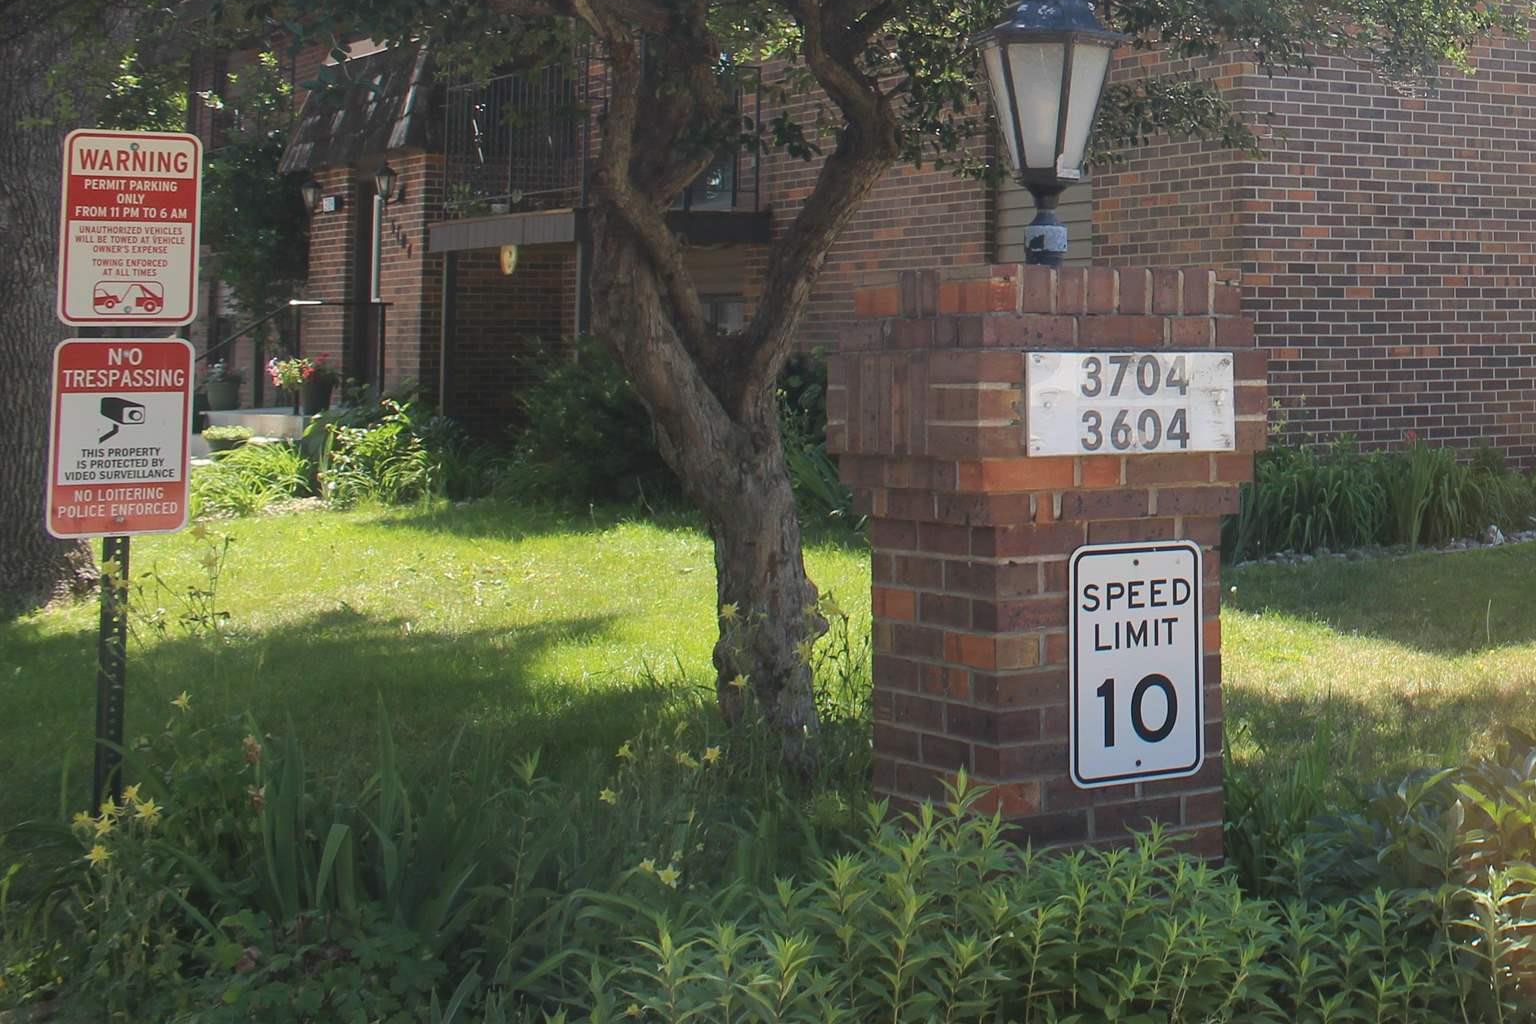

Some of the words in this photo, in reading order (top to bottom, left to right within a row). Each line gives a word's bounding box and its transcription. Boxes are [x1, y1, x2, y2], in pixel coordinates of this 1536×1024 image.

[80, 148, 188, 173] WARNING
[84, 178, 127, 190] PERMIT
[129, 179, 178, 192] PARKING
[116, 193, 145, 205] ONLY
[75, 206, 107, 217] FROM
[110, 207, 120, 217] 11
[123, 207, 139, 218] PM
[143, 207, 157, 218] TO
[160, 208, 168, 218] 6
[170, 208, 187, 219] AM
[79, 225, 142, 234] UNAUTHORIZED
[145, 226, 183, 235] VEHICLES
[75, 235, 94, 244] WILL
[97, 235, 107, 244] BE
[111, 236, 138, 244] TOWED
[140, 236, 150, 244] AT
[153, 236, 185, 245] VEHICLE
[93, 245, 130, 253] OWNER'S
[132, 245, 168, 254] EXPENSE
[92, 258, 124, 267] TOWING
[126, 259, 168, 267] ENFORCED
[102, 268, 112, 276] AT
[116, 268, 130, 277] ALL
[132, 268, 157, 277] TIMES
[108, 348, 143, 366] NO
[63, 369, 184, 388] TRESPASSING
[1081, 354, 1190, 397] 3704
[1081, 408, 1190, 451] 3604
[81, 448, 105, 458] THIS
[108, 447, 161, 457] PROPERTY
[77, 460, 87, 469] IS
[90, 459, 148, 469] PROTECTED
[151, 458, 165, 467] BY
[65, 471, 96, 480] VIDEO
[100, 469, 175, 480] SURVEILLANCE
[74, 490, 92, 502] NO
[98, 487, 164, 501] LOITERING
[58, 505, 105, 518] POLICE
[111, 502, 178, 516] ENFORCED
[1082, 578, 1191, 612] SPEED
[1095, 618, 1178, 651] LIMIT
[1097, 673, 1178, 748] 10
